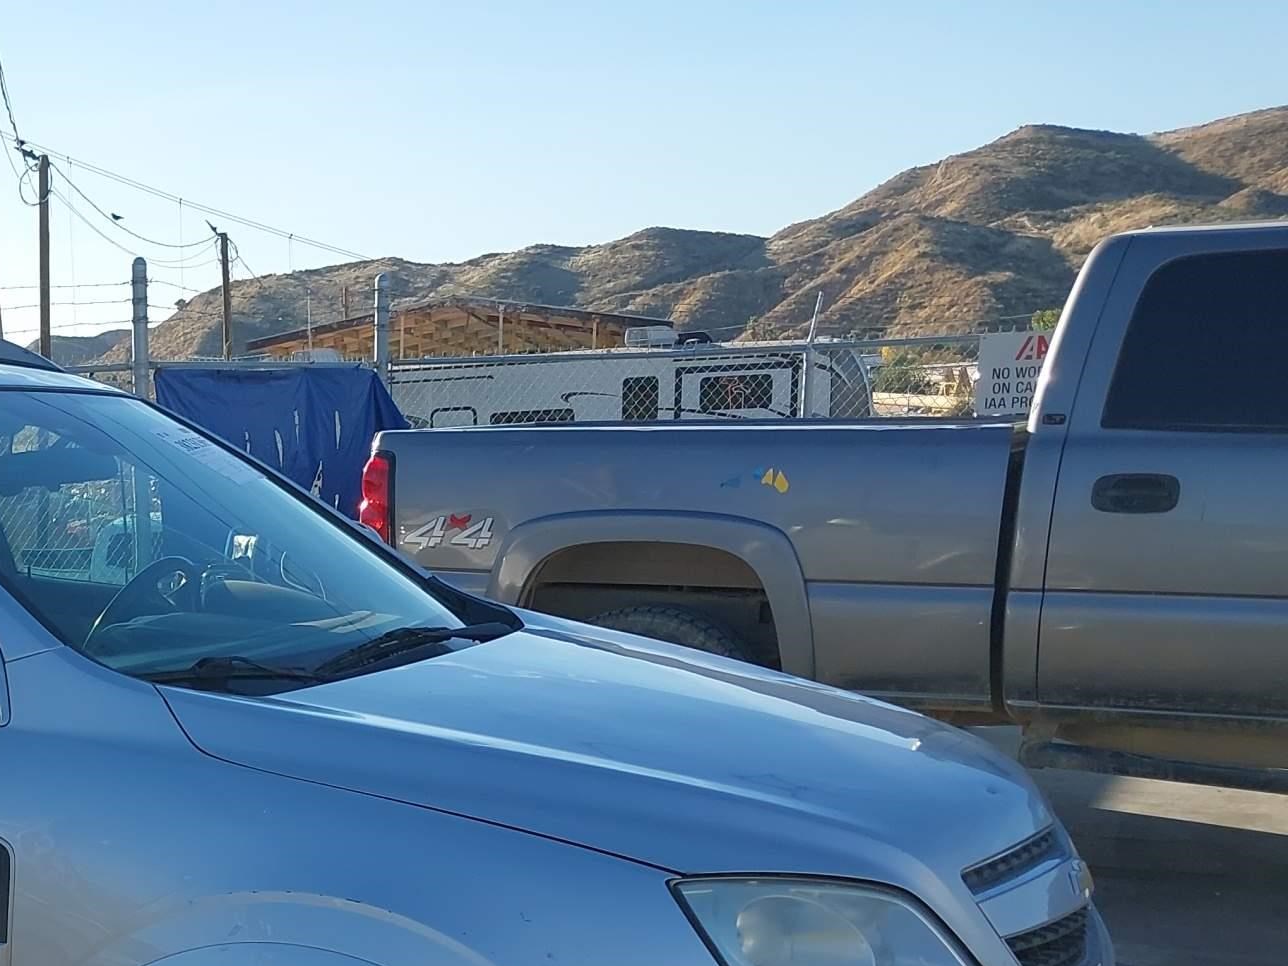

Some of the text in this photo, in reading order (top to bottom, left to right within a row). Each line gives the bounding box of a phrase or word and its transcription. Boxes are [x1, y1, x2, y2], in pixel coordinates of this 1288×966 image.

[992, 366, 1043, 380] NO WO
[992, 381, 1037, 394] ON CA
[984, 397, 1007, 409] IAA
